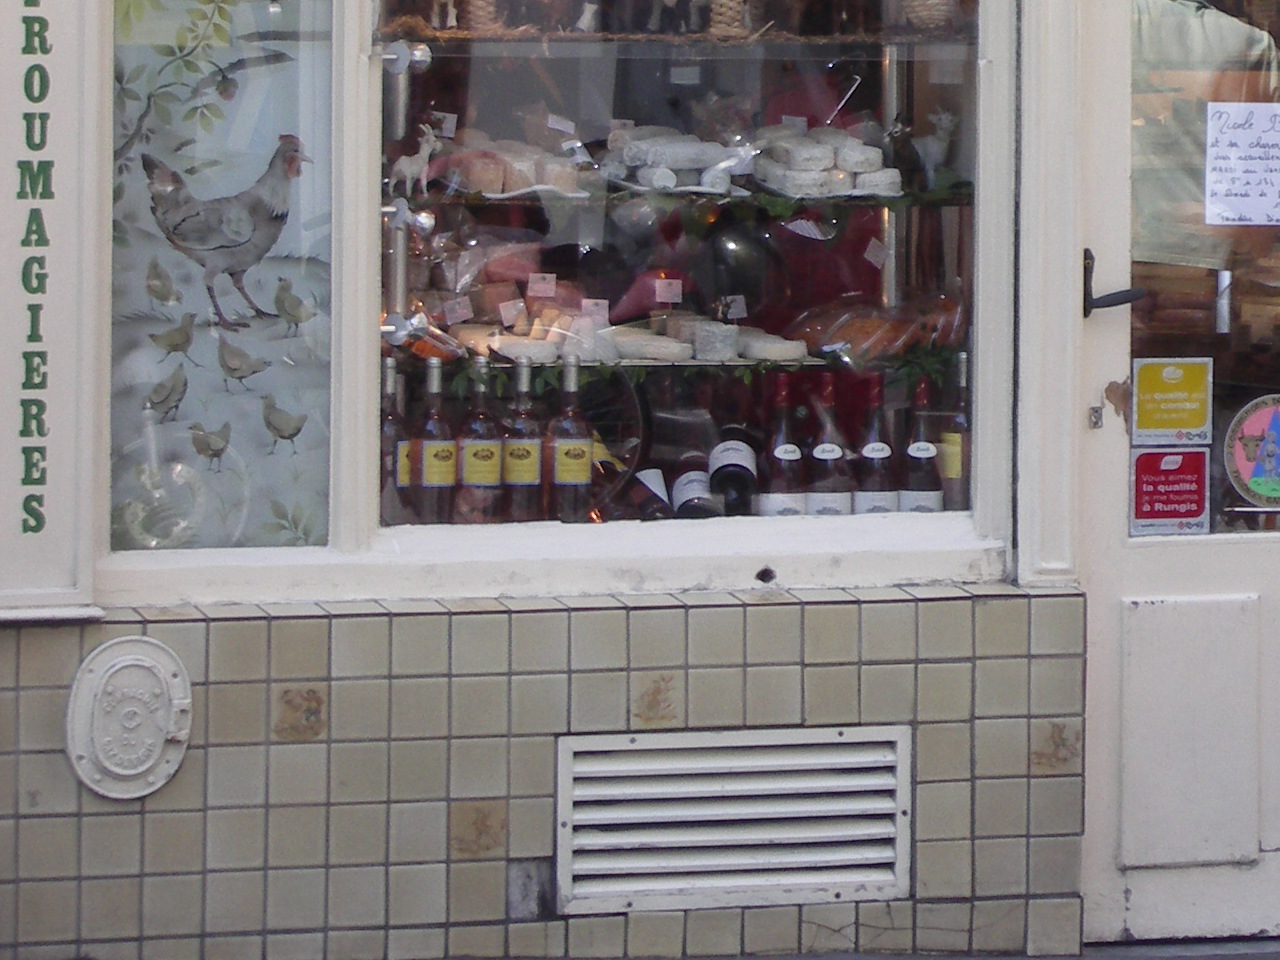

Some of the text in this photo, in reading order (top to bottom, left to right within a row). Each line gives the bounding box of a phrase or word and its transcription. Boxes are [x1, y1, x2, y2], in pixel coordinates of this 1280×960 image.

[1142, 482, 1198, 493] la qualité
[1154, 502, 1198, 513] Rungis
